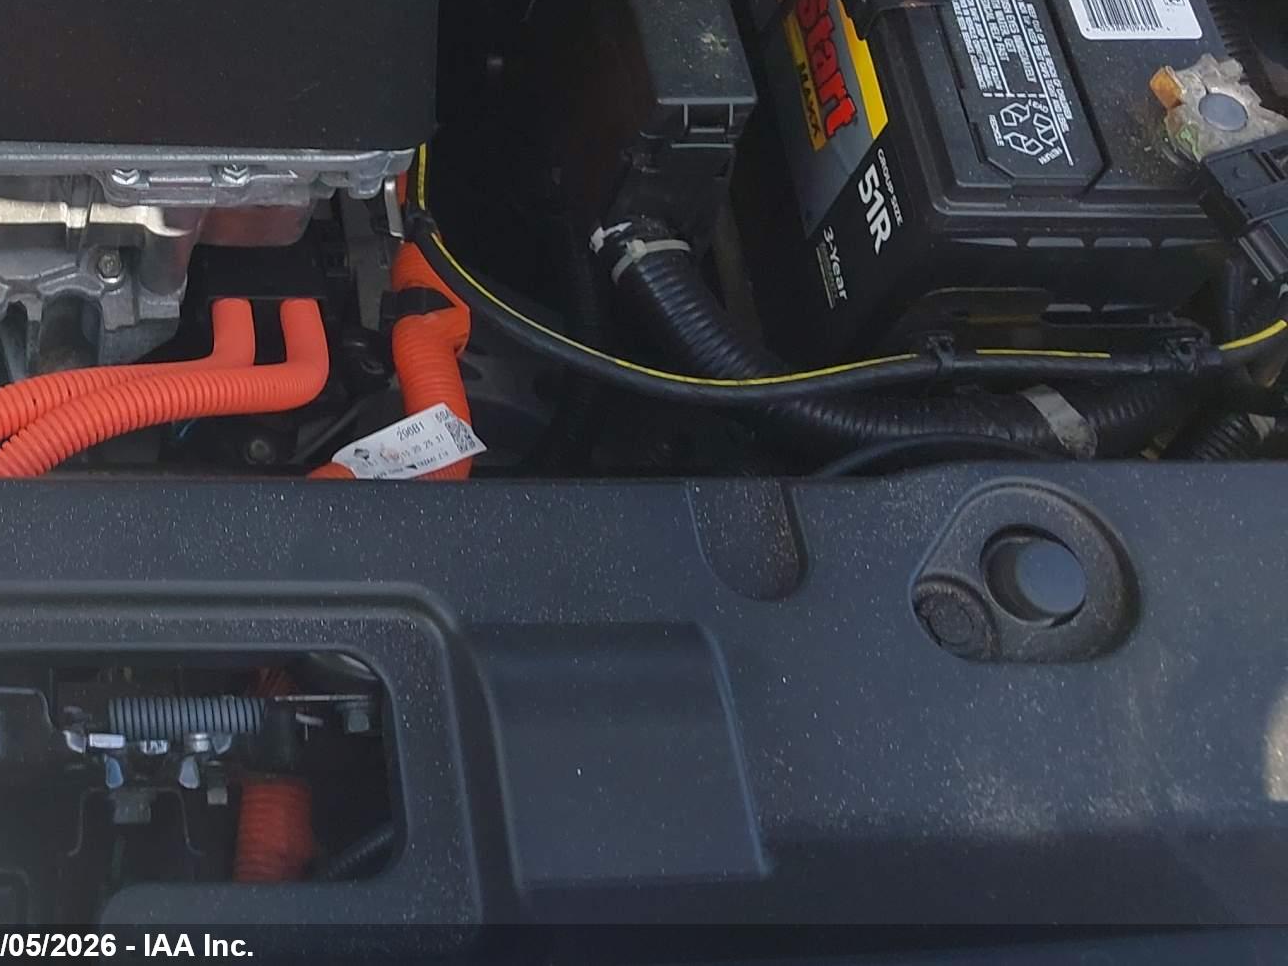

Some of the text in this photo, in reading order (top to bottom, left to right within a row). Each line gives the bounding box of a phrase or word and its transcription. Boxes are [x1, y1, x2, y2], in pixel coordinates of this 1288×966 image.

[877, 148, 894, 194] GROUP
[858, 163, 892, 256] 51R
[823, 225, 848, 300] 3-Year
